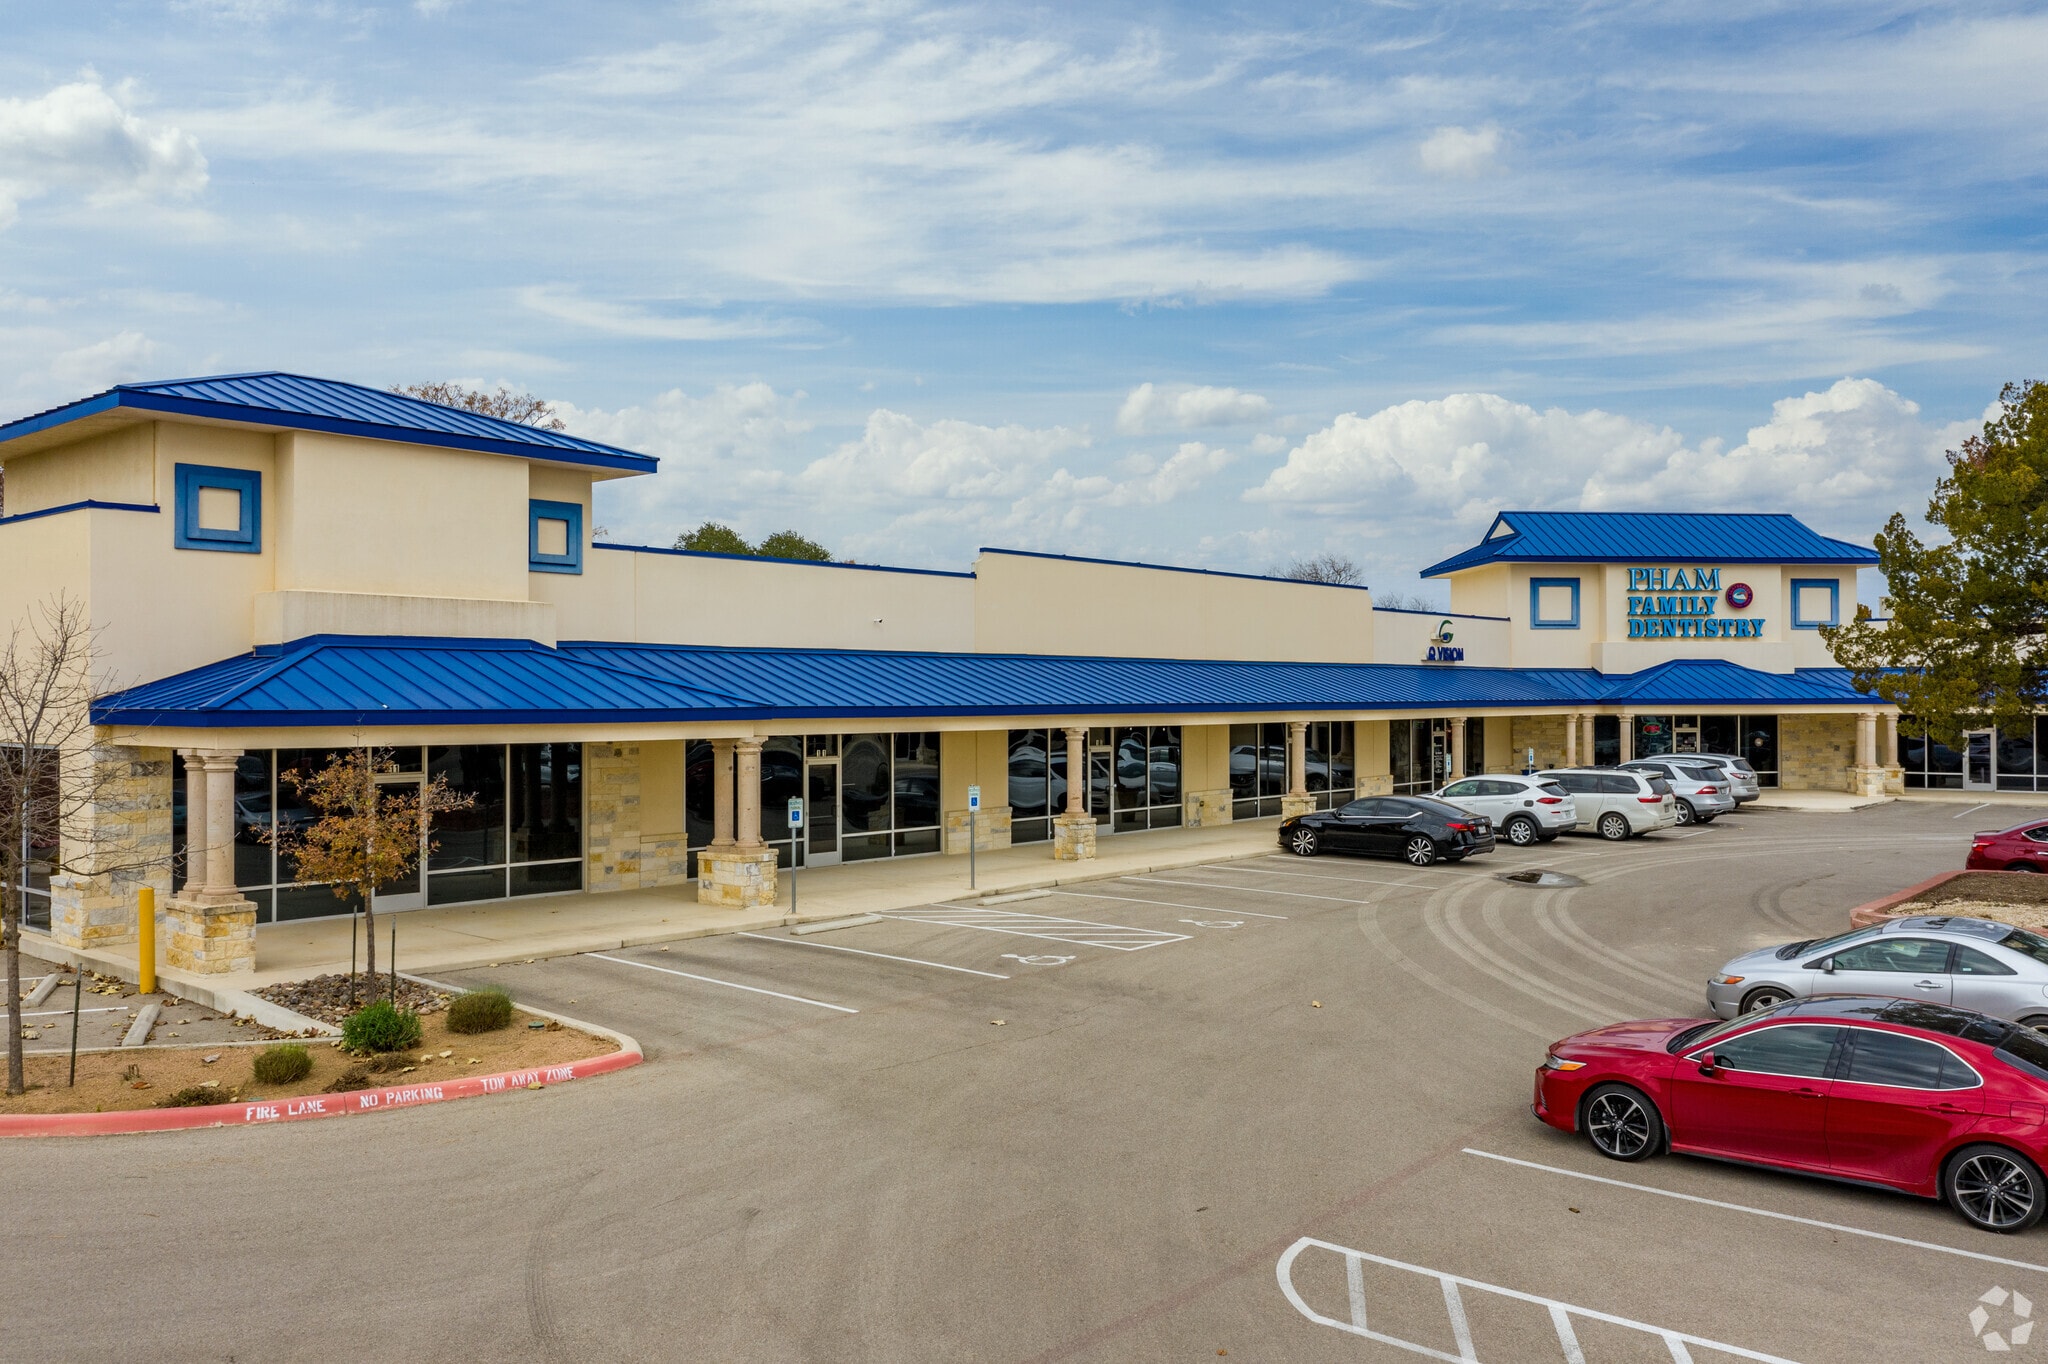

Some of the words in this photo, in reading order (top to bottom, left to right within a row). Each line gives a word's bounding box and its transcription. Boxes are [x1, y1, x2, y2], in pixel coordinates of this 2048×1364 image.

[1627, 568, 1722, 591] PHAM
[1628, 597, 1718, 615] FAMILY
[1628, 619, 1765, 638] DENTISTRY
[1437, 647, 1464, 661] VISION
[246, 1106, 280, 1121] FIRE
[288, 1100, 326, 1115] LANE
[360, 1094, 378, 1108] NO
[386, 1087, 443, 1105] PARKING
[545, 1066, 575, 1081] ZONE
